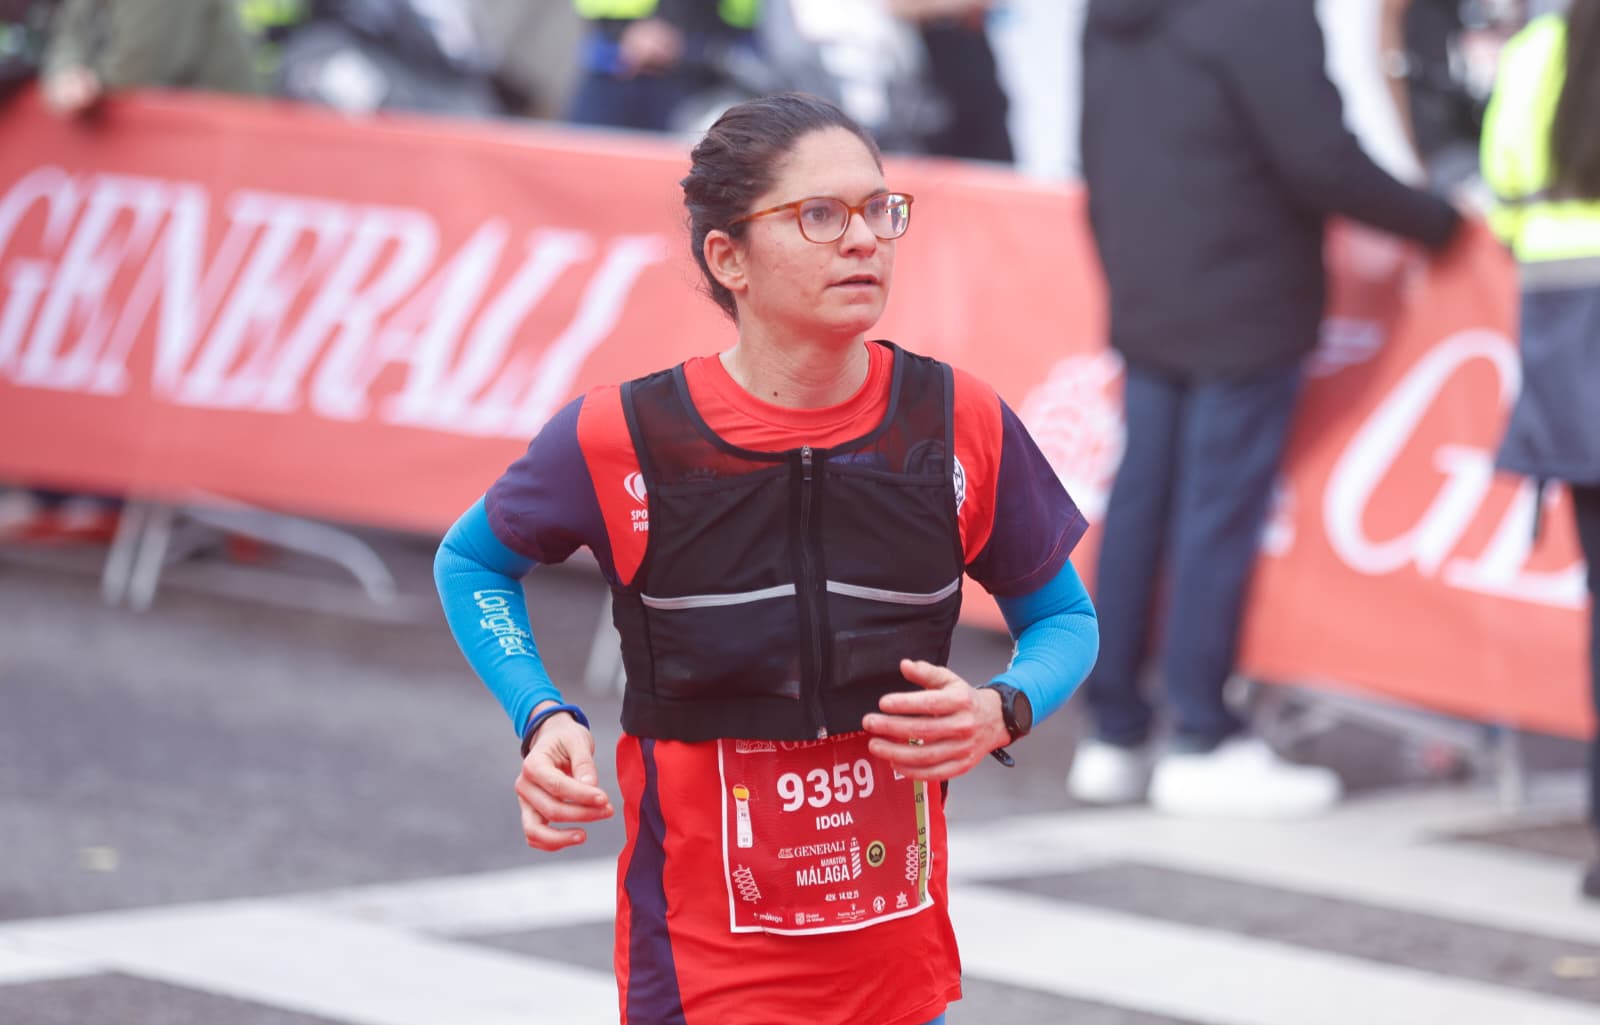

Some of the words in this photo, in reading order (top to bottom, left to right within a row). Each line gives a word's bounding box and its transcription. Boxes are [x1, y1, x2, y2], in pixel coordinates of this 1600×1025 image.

[0, 165, 665, 440] GENERALI
[777, 759, 874, 811] 9359
[815, 811, 854, 831] IDOIA
[794, 840, 846, 858] GENERALI
[796, 864, 851, 887] MÁLAGA
